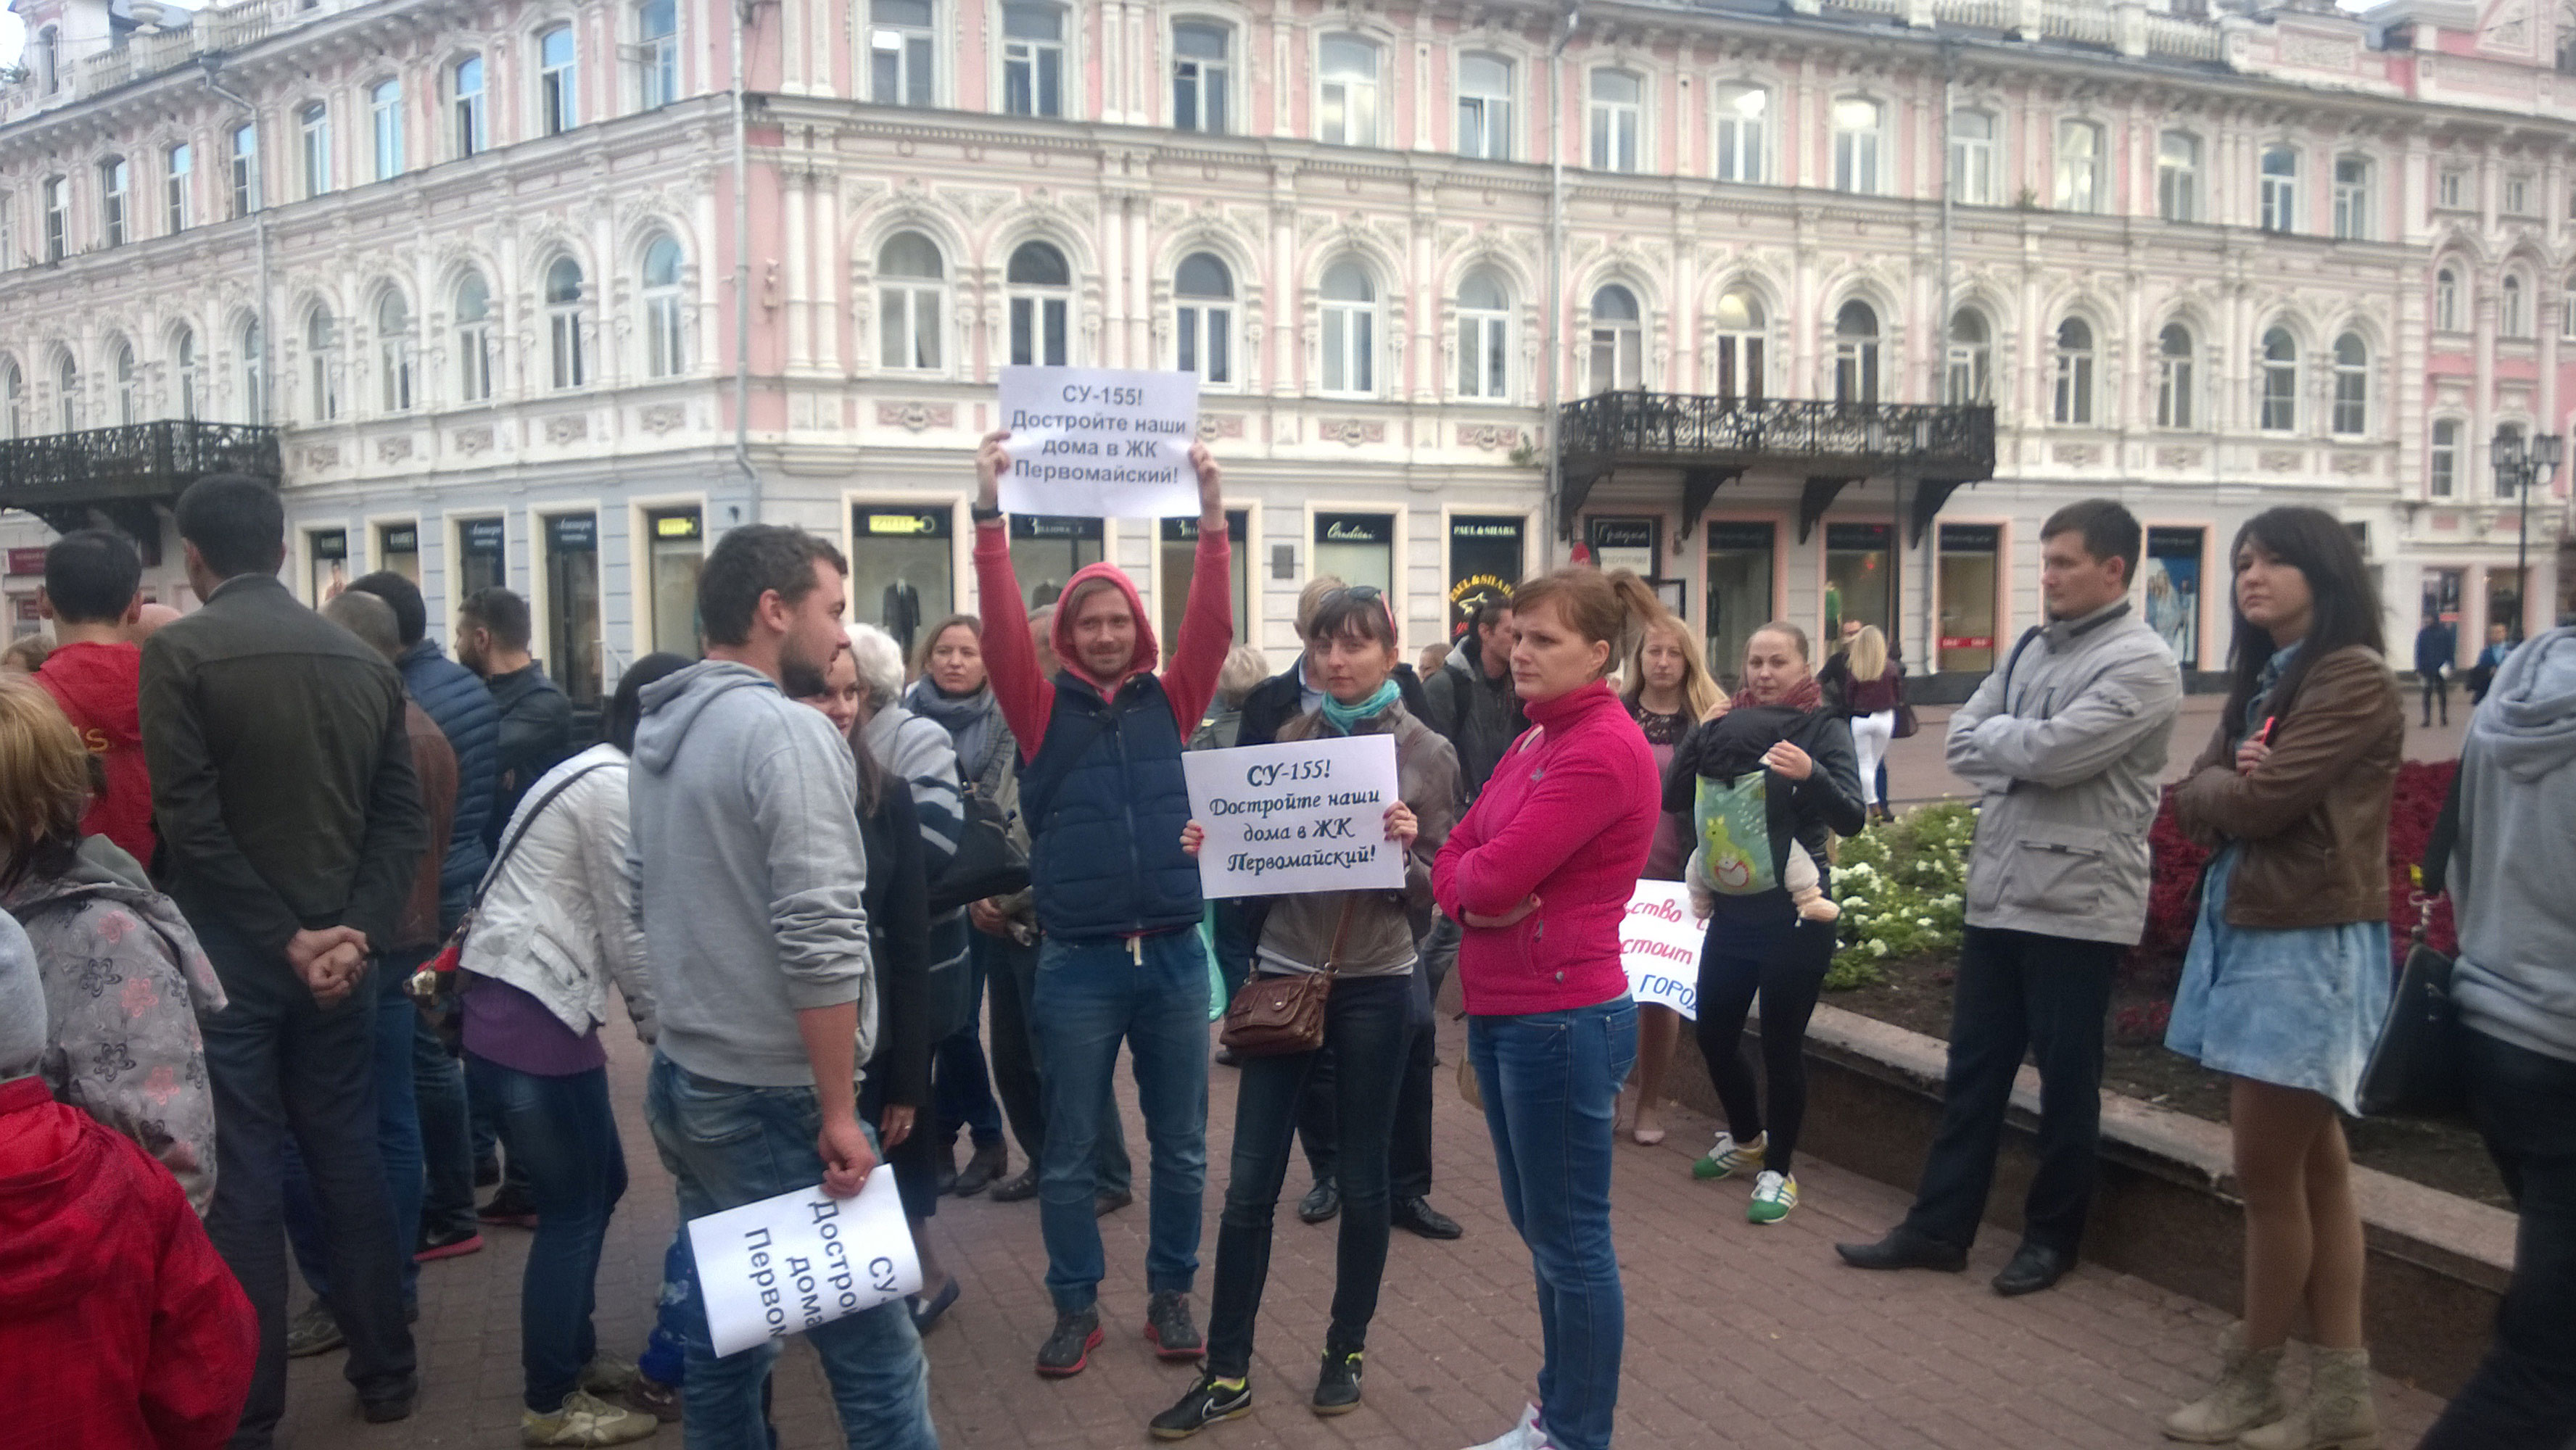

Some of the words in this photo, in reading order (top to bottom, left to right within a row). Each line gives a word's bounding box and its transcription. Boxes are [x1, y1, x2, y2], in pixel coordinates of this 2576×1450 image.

[1062, 384, 1143, 406] СУ-155!
[1011, 410, 1128, 432] Достройте
[1135, 418, 1186, 434] наши
[1042, 439, 1098, 456] дома
[1107, 443, 1118, 457] в
[1126, 440, 1157, 458] ЖК
[1015, 459, 1178, 484] Первомайский!
[1247, 759, 1331, 787] СУ-155!
[1209, 792, 1321, 819] Достройте
[1328, 789, 1380, 806] наши
[1243, 823, 1291, 842] дома
[1297, 826, 1306, 839] в
[1312, 817, 1355, 839] ЖК
[1226, 844, 1376, 876] Первомайский!
[785, 1255, 823, 1328] дома
